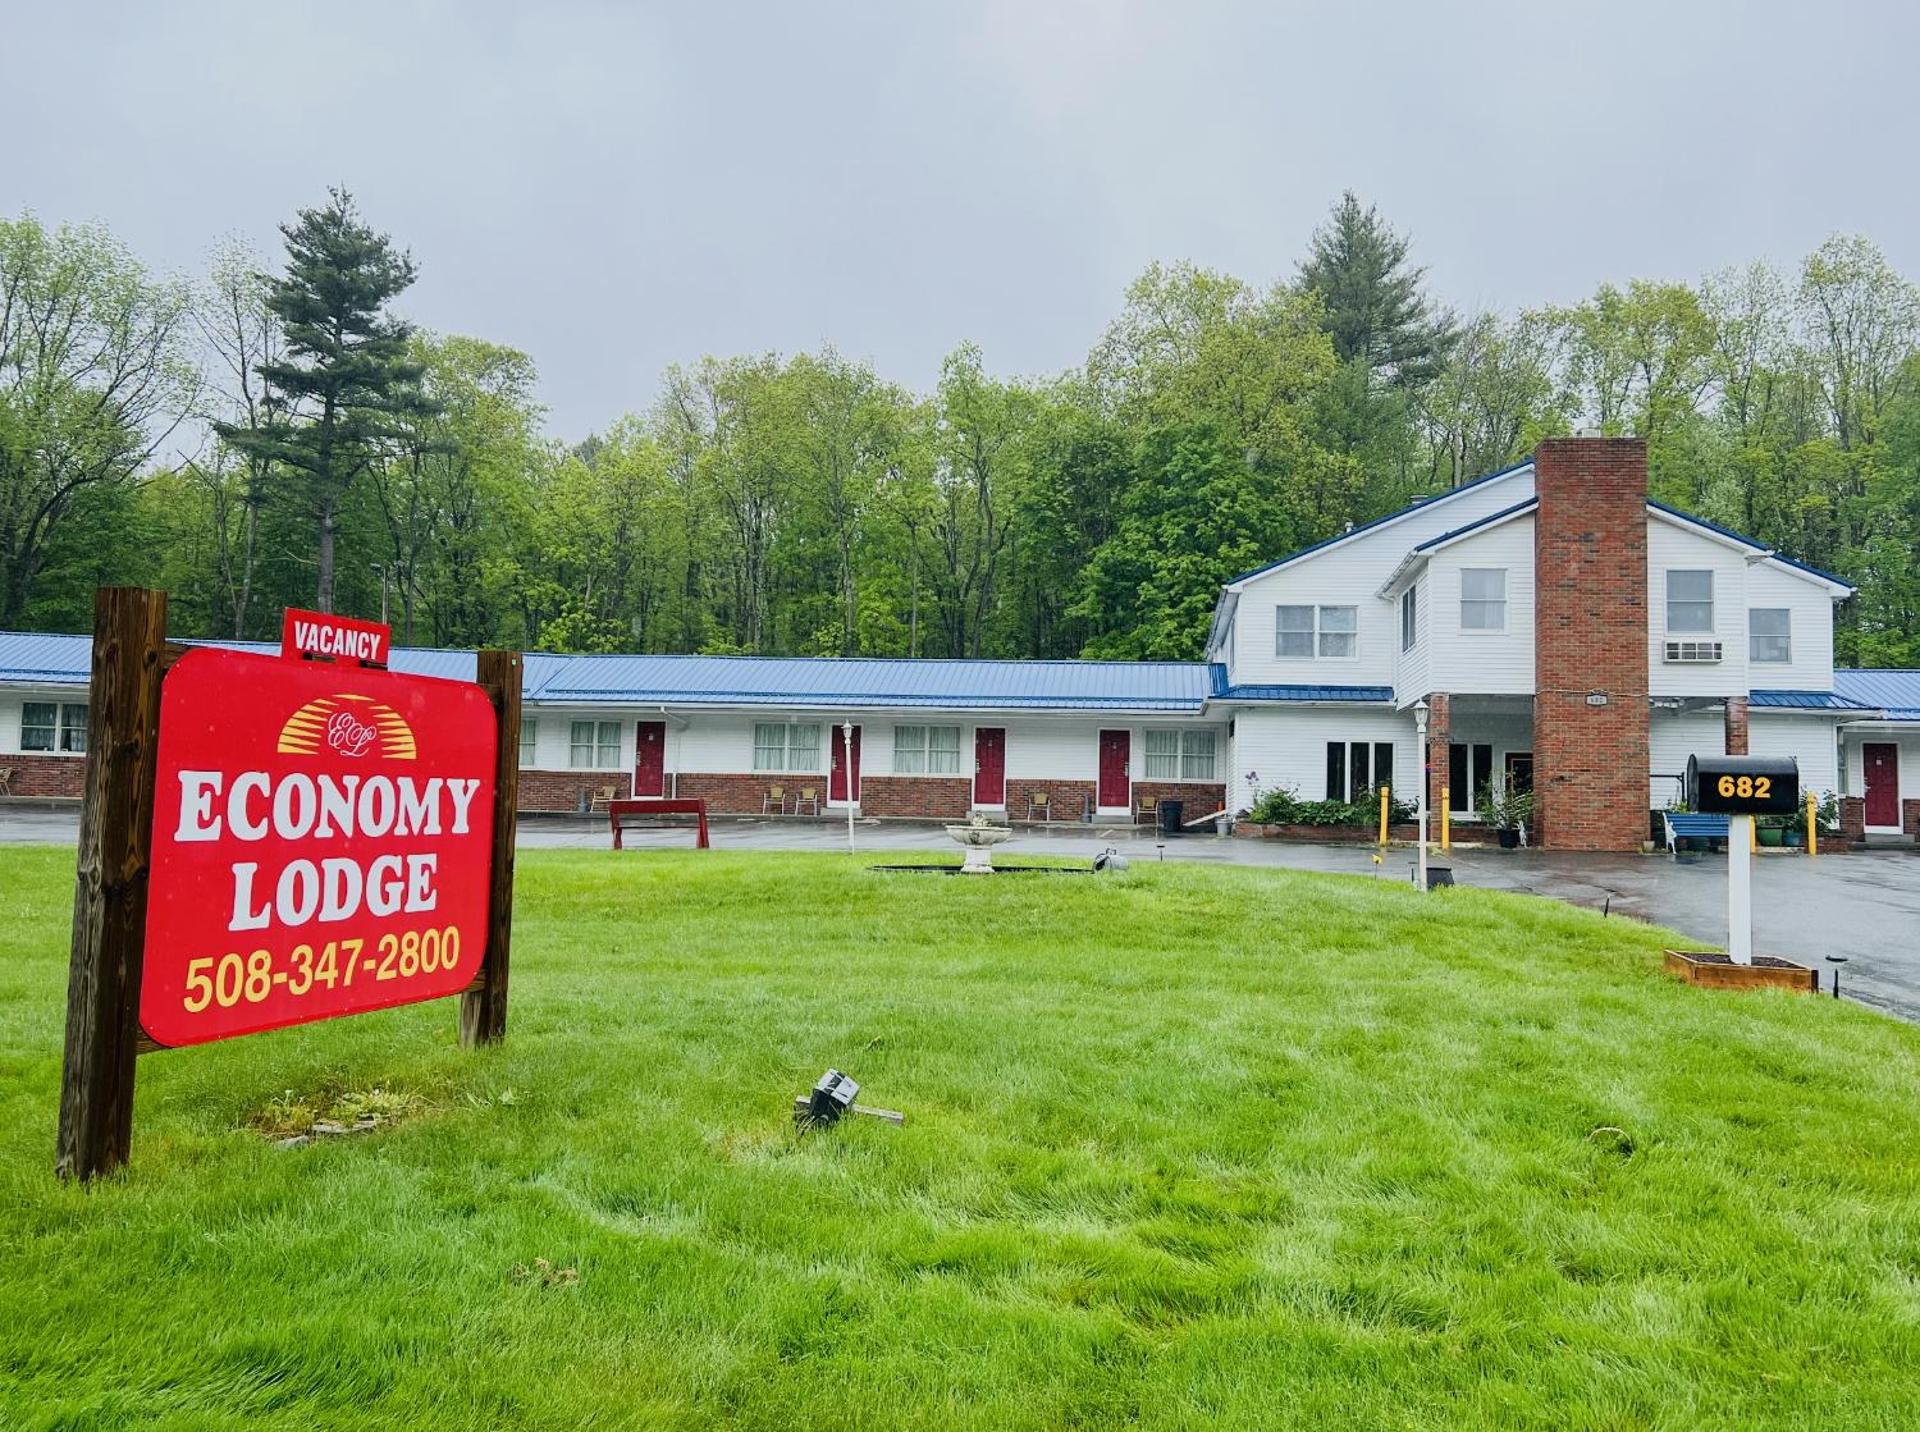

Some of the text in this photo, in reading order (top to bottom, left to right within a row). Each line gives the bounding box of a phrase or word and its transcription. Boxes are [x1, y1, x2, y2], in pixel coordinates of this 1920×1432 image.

[294, 620, 381, 660] VACANCY
[174, 770, 480, 842] ECONOMY
[1718, 776, 1771, 799] 682
[228, 854, 438, 932] LODGE
[183, 926, 460, 1013] 508-347-2800
